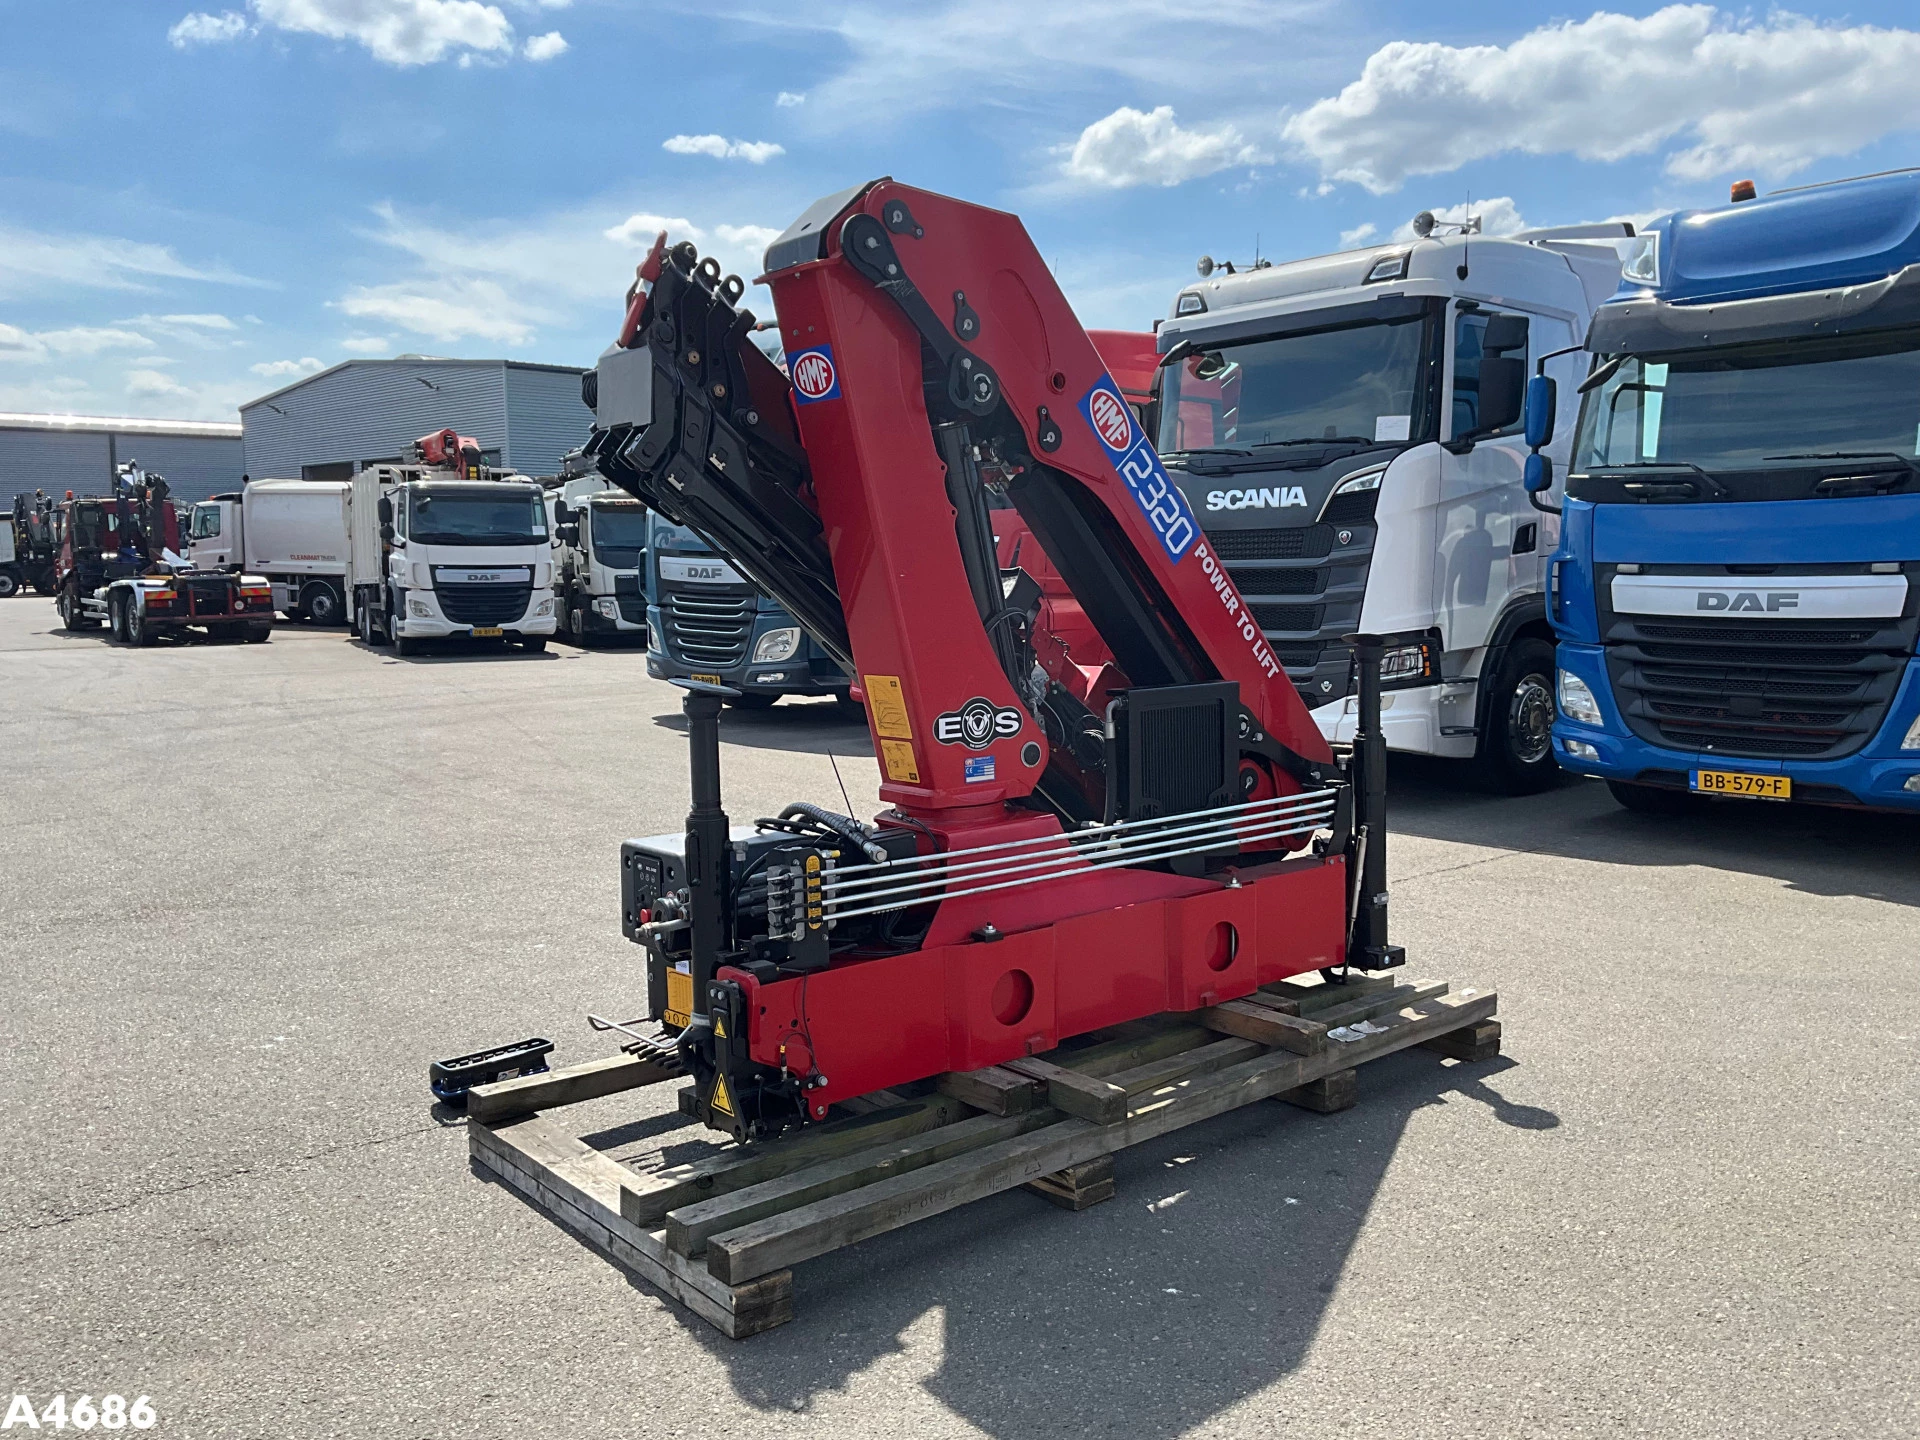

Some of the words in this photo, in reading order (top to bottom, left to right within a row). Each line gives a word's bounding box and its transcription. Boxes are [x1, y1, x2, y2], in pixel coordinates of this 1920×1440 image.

[797, 357, 828, 393] HMF
[1093, 395, 1128, 443] HMF
[1122, 449, 1194, 555] 2320
[1206, 486, 1308, 511] SCANIA
[687, 567, 723, 579] DAF
[1194, 543, 1238, 616] POWER
[1237, 610, 1256, 642] TO
[1252, 638, 1280, 678] LIFT
[1697, 592, 1799, 612] DAF
[1703, 774, 1782, 794] BB-579-F
